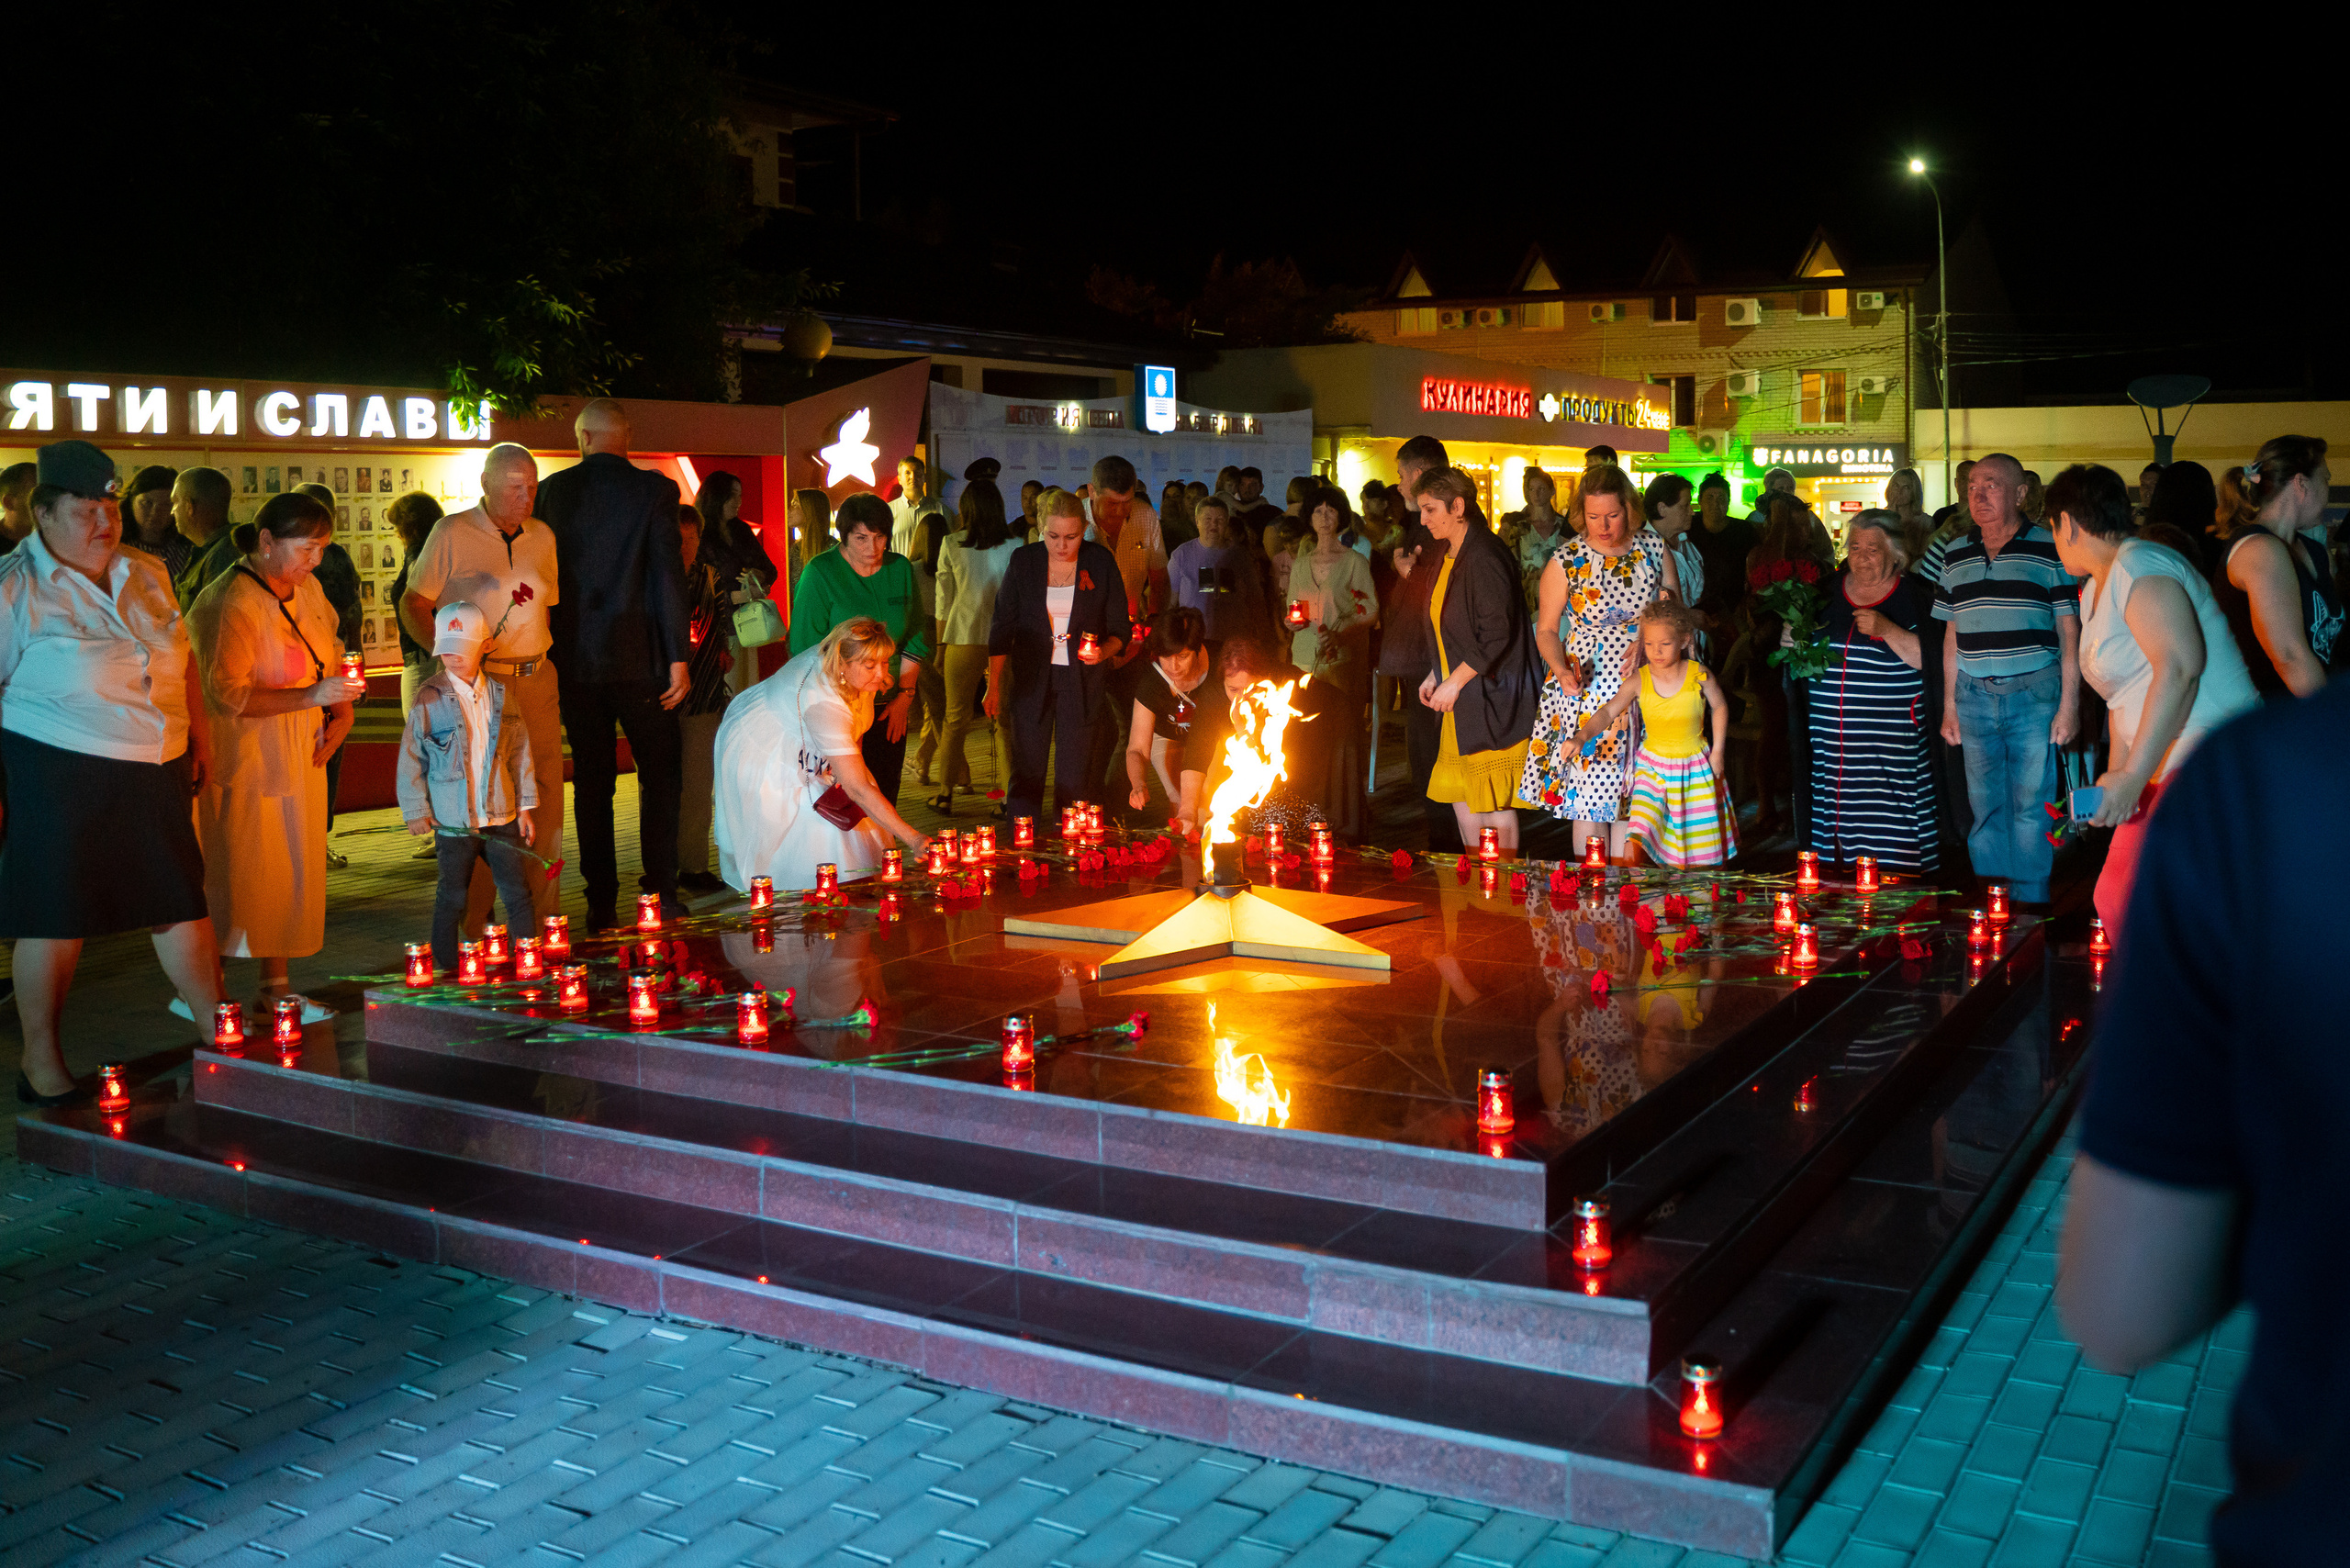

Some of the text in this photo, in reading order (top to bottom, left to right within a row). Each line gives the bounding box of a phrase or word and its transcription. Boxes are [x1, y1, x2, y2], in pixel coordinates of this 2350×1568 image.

[7, 380, 492, 442] ЯТИ И СЛАВЫ
[1422, 380, 1531, 419] КУЛИНАРИЯ
[1561, 396, 1636, 427] ПРОДУКТЫ
[1636, 398, 1652, 429] 24
[1770, 448, 1894, 465] FANAGORIA
